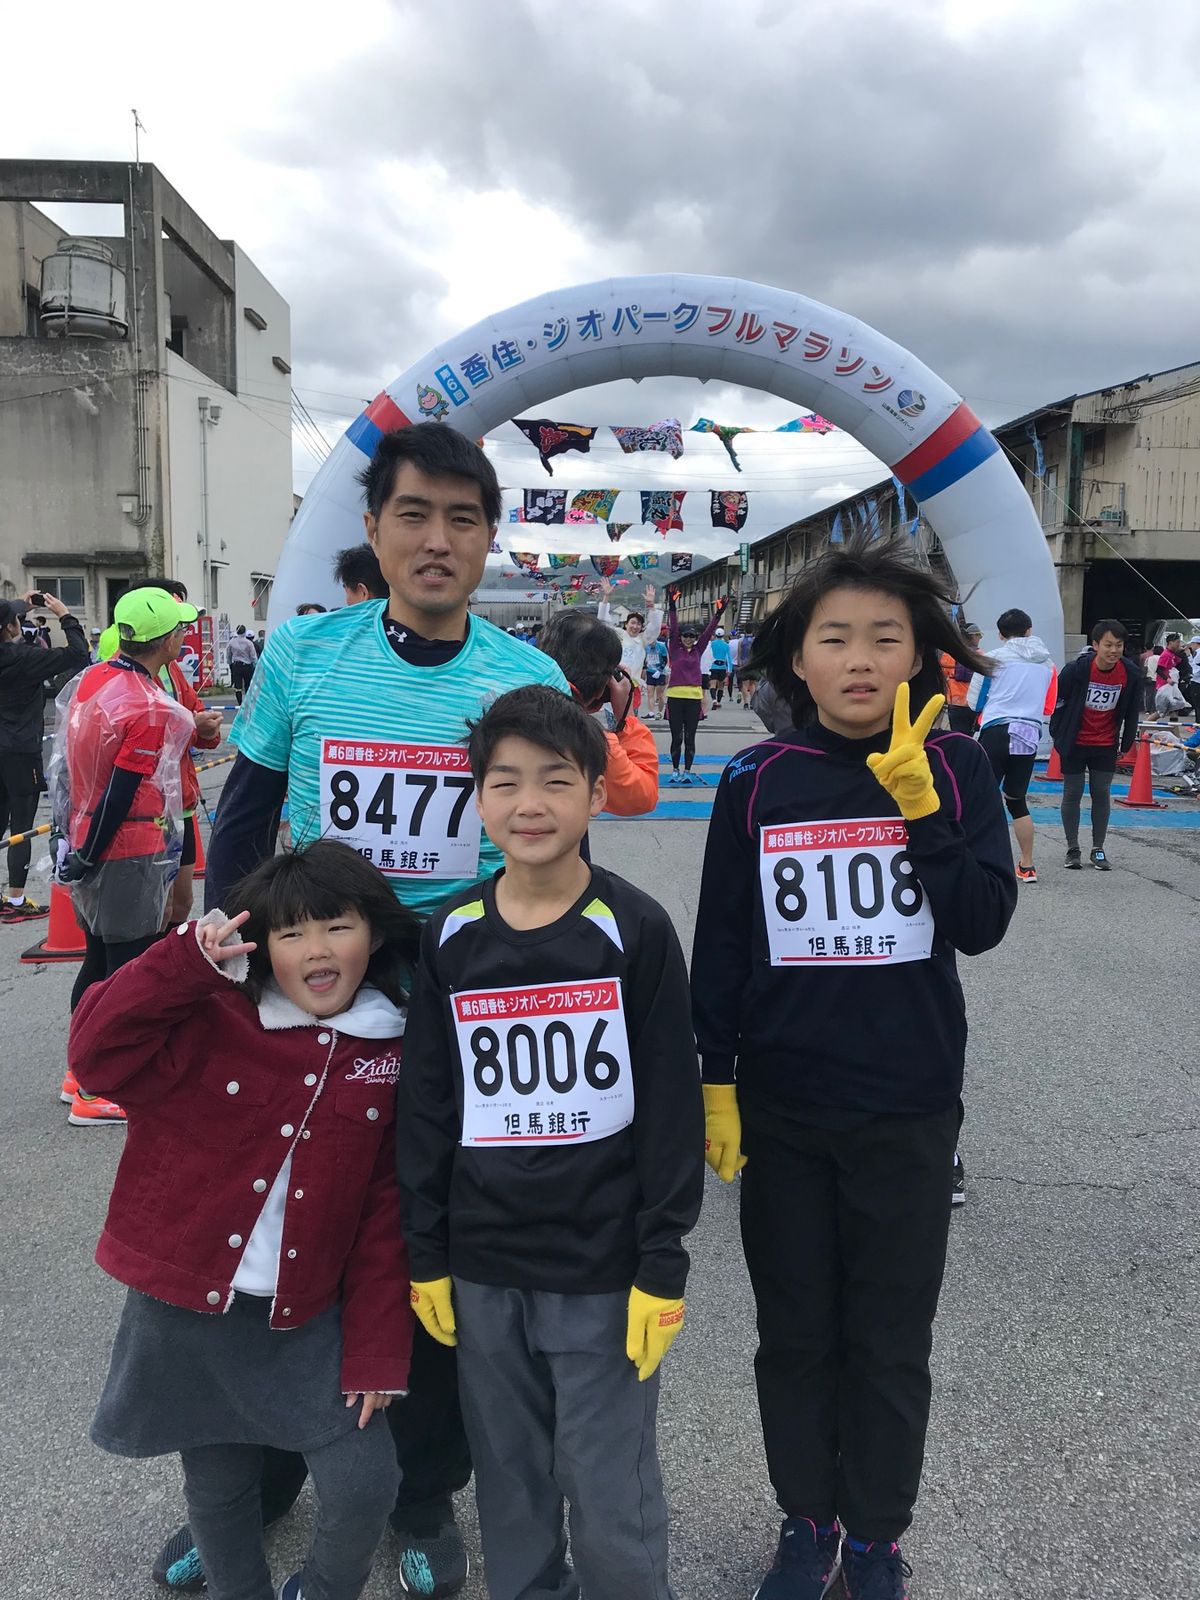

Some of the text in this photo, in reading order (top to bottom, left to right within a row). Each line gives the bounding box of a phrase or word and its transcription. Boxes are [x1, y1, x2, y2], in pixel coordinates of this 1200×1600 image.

[1086, 688, 1117, 703] 1291
[328, 744, 470, 767] 第6回香住・ジオパークフルマラソ
[329, 770, 475, 839] 8477
[768, 825, 909, 848] 第6回香住・ジオパークフルマラ
[773, 850, 924, 922] 8108
[808, 934, 898, 956] 但馬銀行
[461, 988, 613, 1016] 第6回香住・ジオパークフルマラソン
[470, 1017, 621, 1097] 8006
[504, 1110, 591, 1135] 但馬銀行
